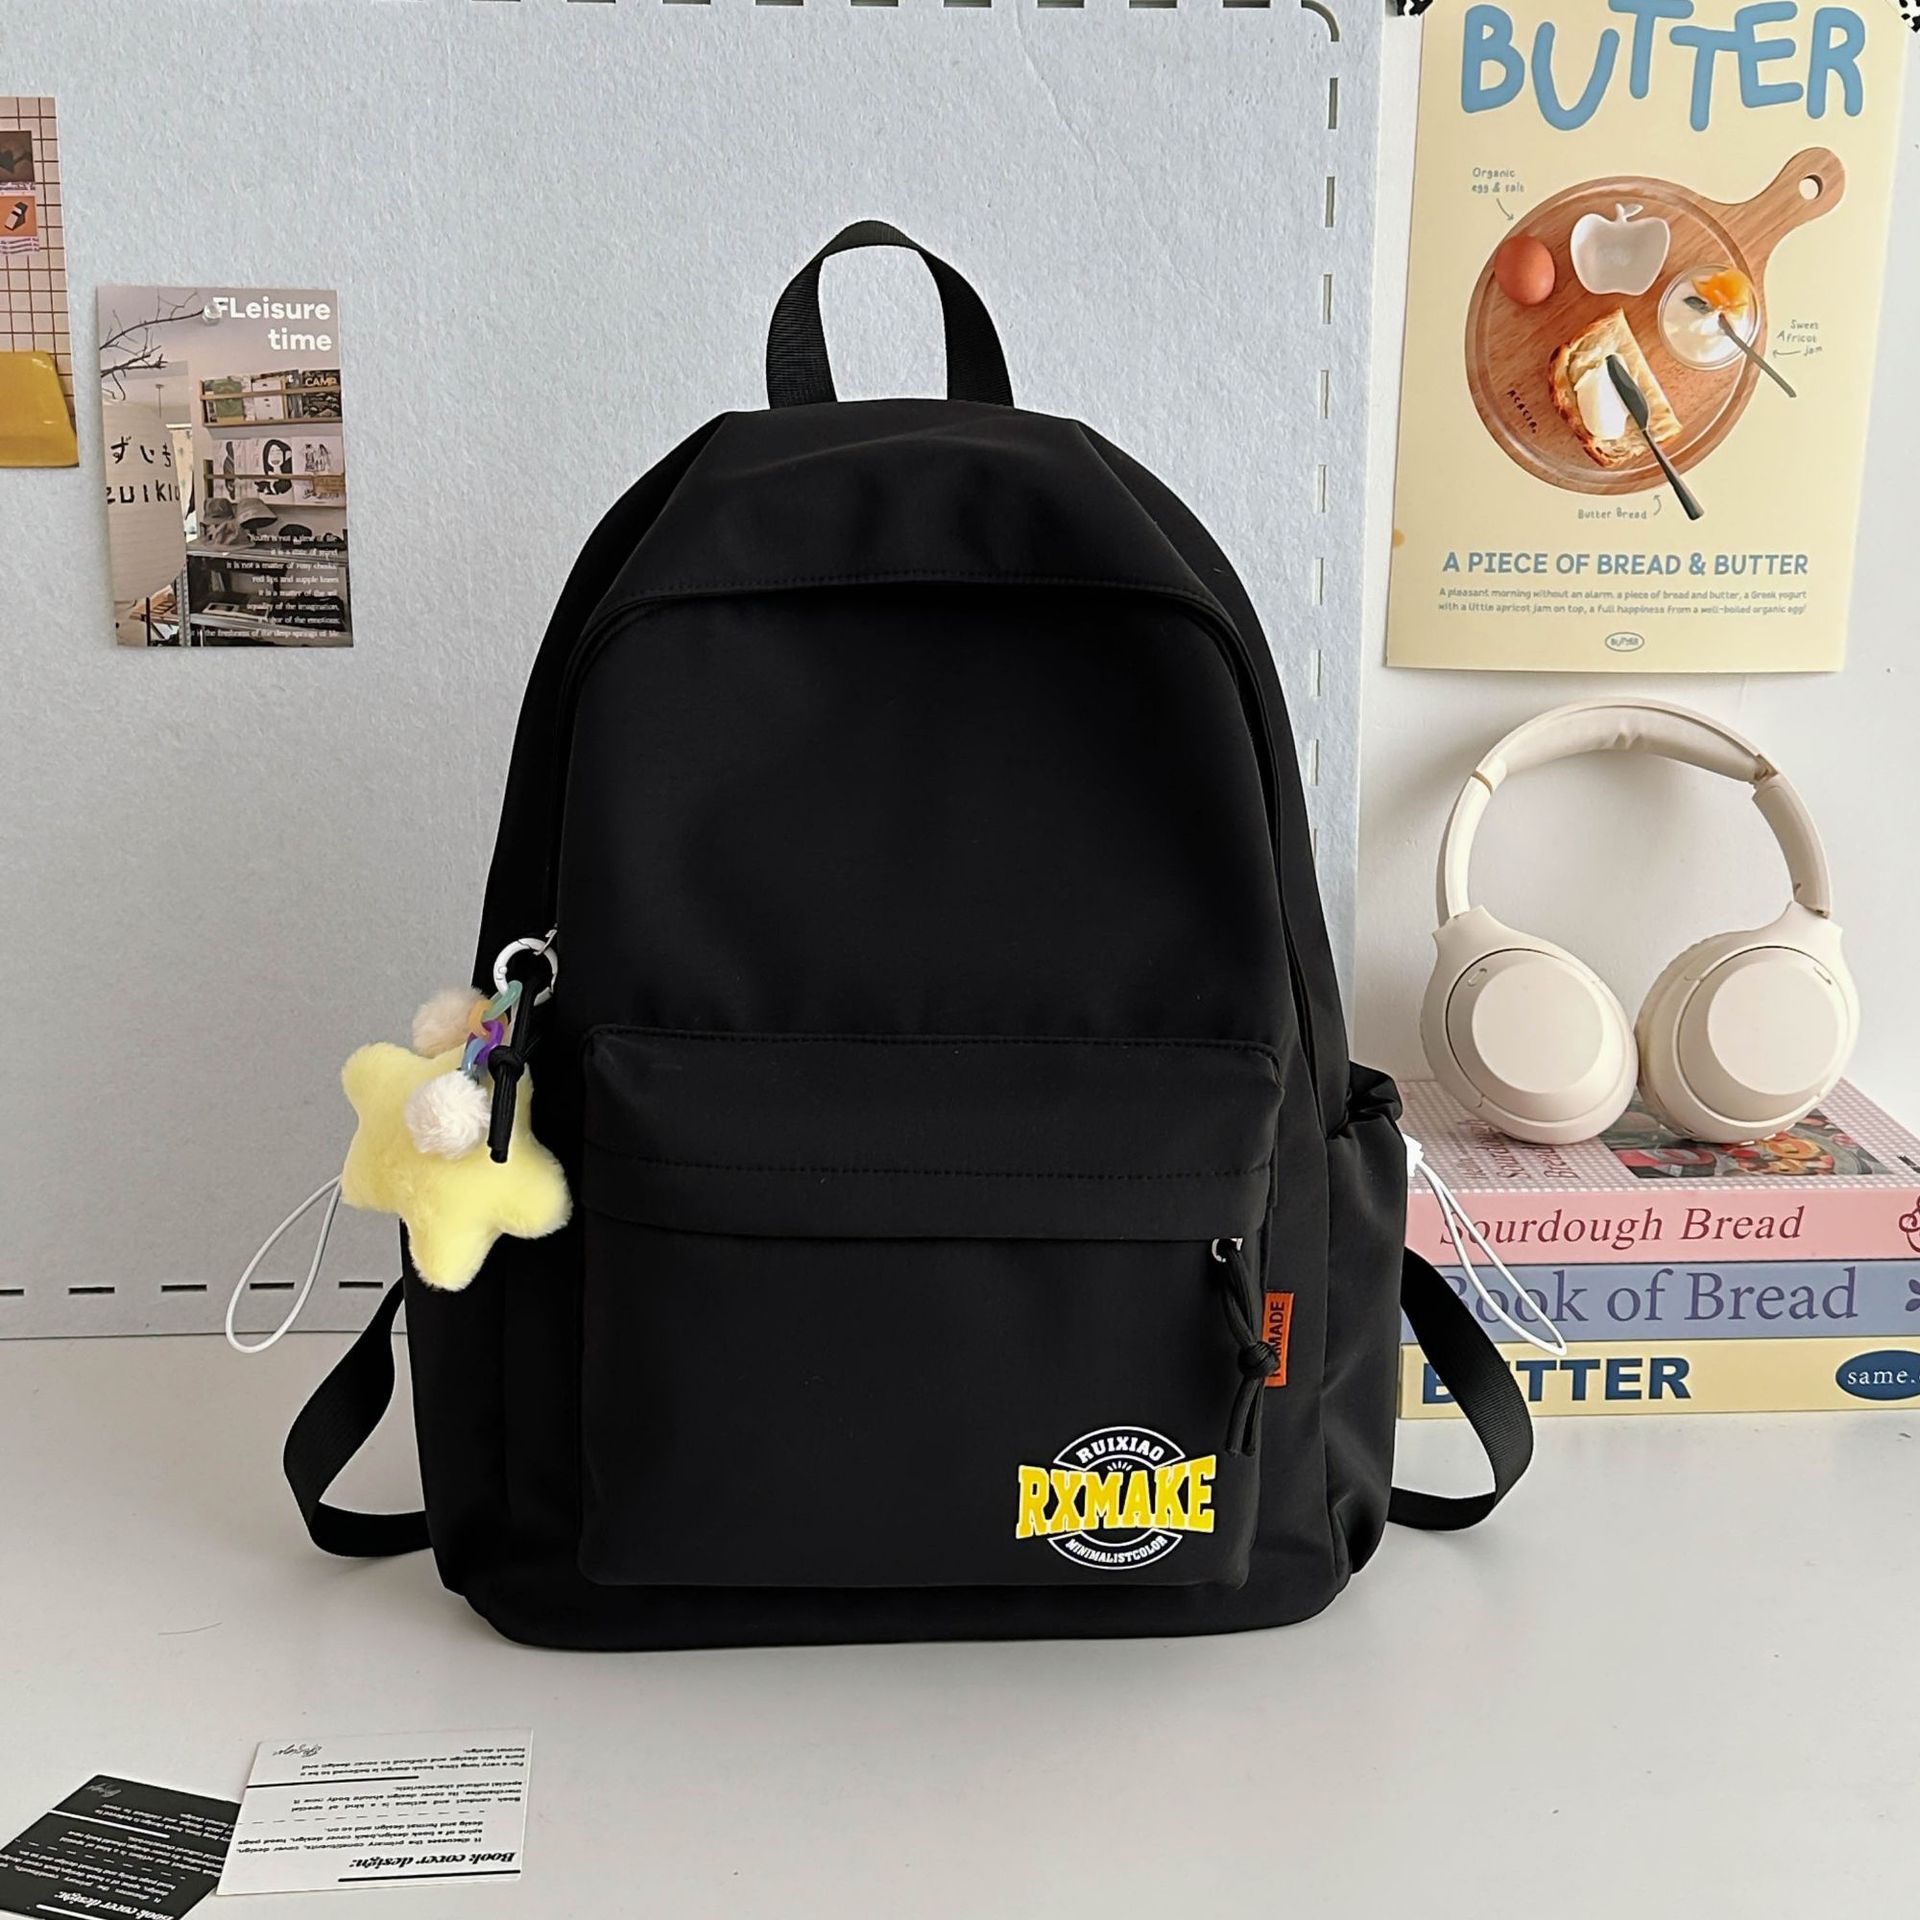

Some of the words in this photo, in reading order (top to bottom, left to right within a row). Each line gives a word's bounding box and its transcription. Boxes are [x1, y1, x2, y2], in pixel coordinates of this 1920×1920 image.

[1461, 0, 1865, 131] BUTTER
[1472, 167, 1515, 179] Organic
[267, 327, 332, 351] time
[1616, 507, 1647, 519] Bread
[1442, 552, 1460, 572] A
[1468, 552, 1548, 574] PIECE
[1556, 554, 1590, 574] OF
[1597, 554, 1682, 575] BREAD
[1689, 553, 1706, 575] &
[1715, 555, 1808, 575] BUTTER
[1491, 590, 1532, 599] morning
[1624, 591, 1649, 600] piece
[1663, 591, 1690, 599] bread
[1496, 604, 1532, 613] apricot
[1440, 1206, 1664, 1250] Sourdough
[1679, 1205, 1805, 1241] Bread
[1607, 1267, 1674, 1322] of
[1684, 1266, 1859, 1322] Bread
[1268, 1301, 1284, 1378] MADE
[1422, 1356, 1692, 1405] BTTER
[1848, 1370, 1920, 1385] same.
[1076, 1436, 1165, 1464] RUIXIAO
[1015, 1454, 1217, 1540] RXMAKE
[1064, 1535, 1169, 1564] MINIMALISTCOLOR
[350, 1857, 413, 1868] design:
[416, 1855, 465, 1864] cover
[469, 1853, 514, 1864] Book
